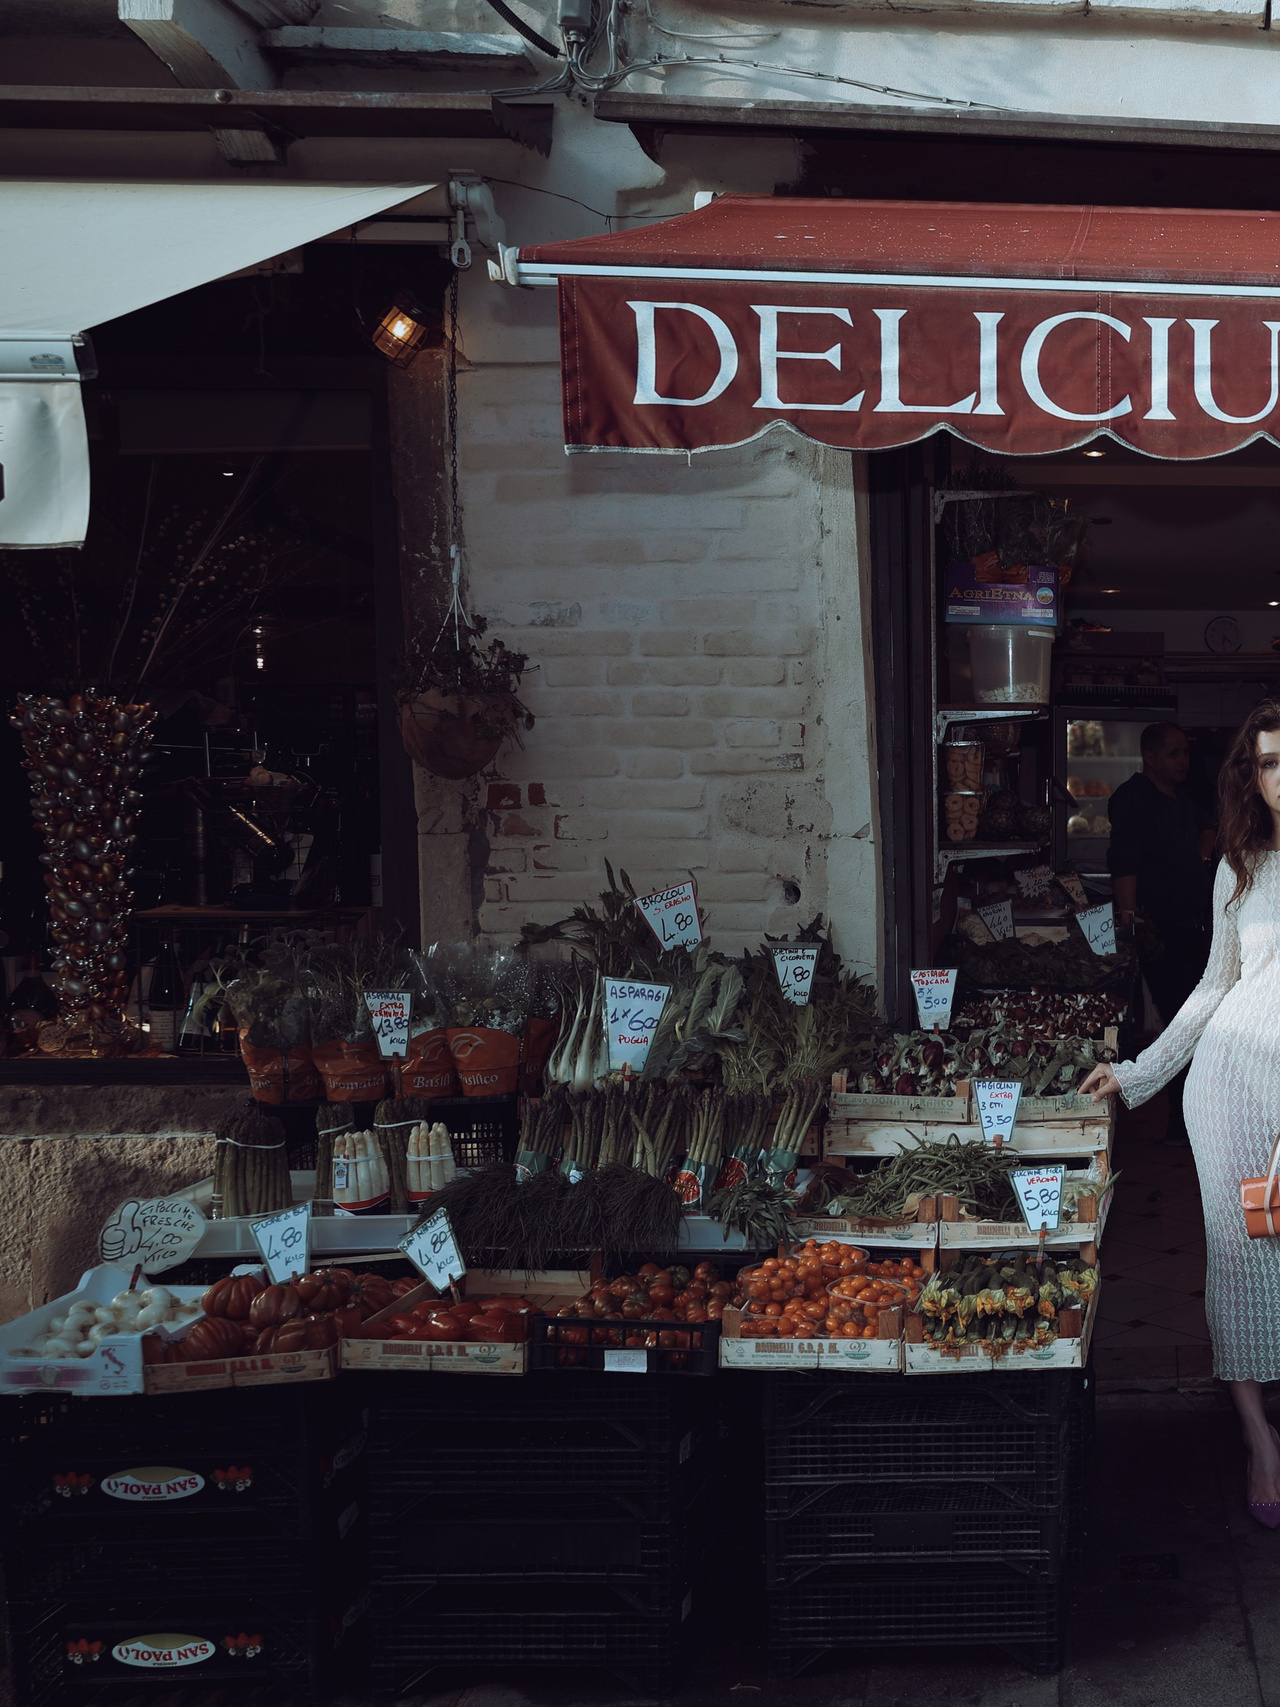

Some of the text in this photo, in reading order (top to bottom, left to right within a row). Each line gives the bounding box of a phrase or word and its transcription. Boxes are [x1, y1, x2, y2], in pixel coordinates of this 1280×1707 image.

[641, 886, 686, 910] BROCCOLI
[661, 912, 694, 942] 4.80
[681, 938, 699, 947] KILO
[781, 965, 810, 988] 4.80
[366, 992, 404, 1001] ASPARAGI
[610, 985, 665, 1001] ASPARAGI
[976, 1080, 1017, 1090] FAGIOLINI
[989, 1091, 1013, 1100] EXTRA
[980, 1101, 987, 1110] 3
[142, 1215, 196, 1231] FRESCHE
[140, 1227, 183, 1251] 4.00
[267, 1227, 302, 1260] 4.80
[418, 1231, 447, 1266] 4.80
[167, 1477, 198, 1495] SAN
[178, 1643, 209, 1661] SAN
